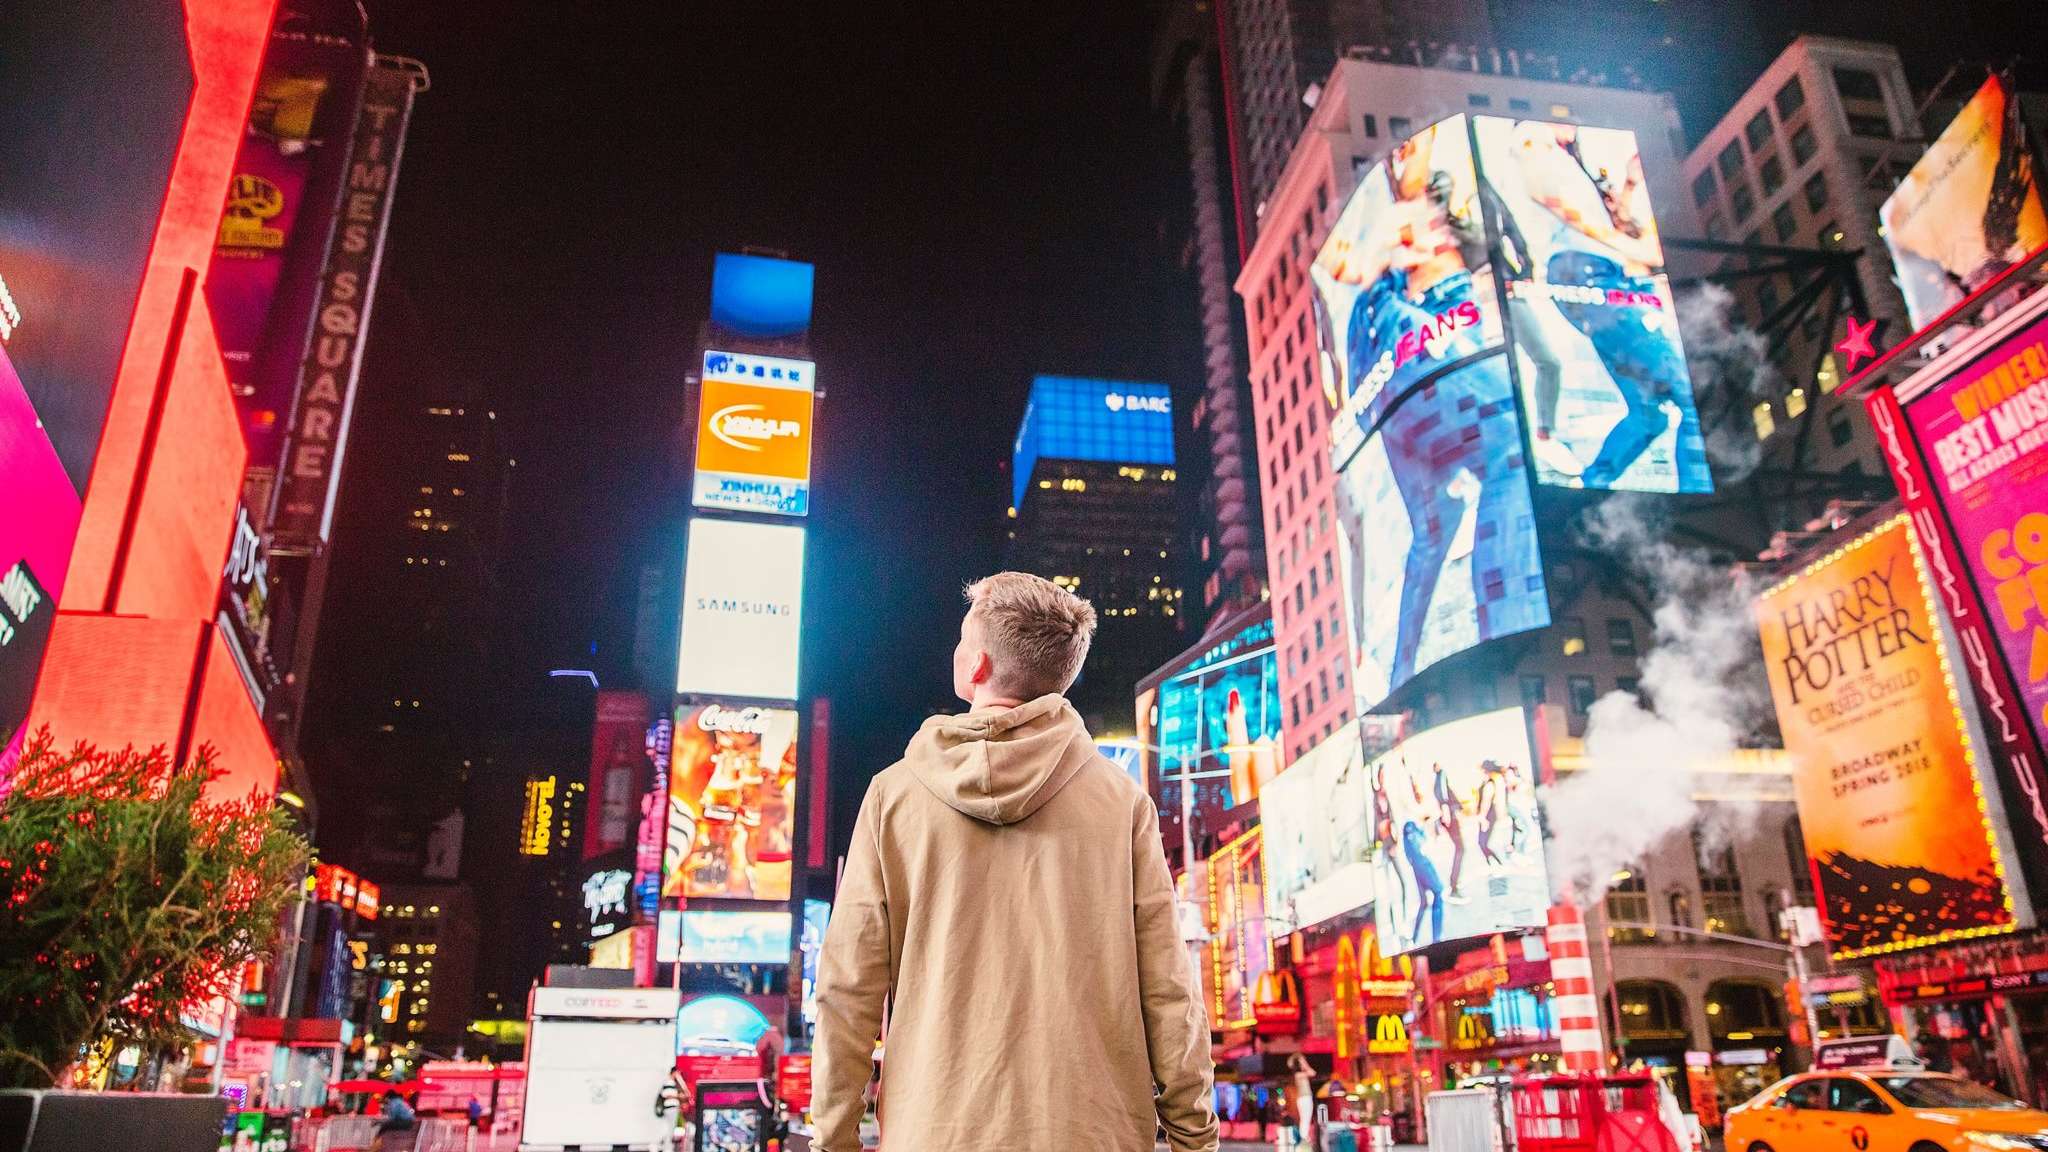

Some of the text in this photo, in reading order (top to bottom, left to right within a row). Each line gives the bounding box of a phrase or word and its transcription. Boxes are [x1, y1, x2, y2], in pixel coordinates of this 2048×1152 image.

[294, 104, 397, 478] TIMES SQUARE
[1395, 301, 1481, 368] JEANS
[1933, 414, 1994, 477] BEST
[720, 480, 782, 498] XINHUA
[697, 598, 790, 616] SAMSUNG
[1781, 556, 1897, 656] HARRY
[1783, 608, 1927, 705] POTTER
[1868, 667, 1921, 701] CHILD
[1832, 739, 1921, 780] BROADWAY
[1833, 770, 1890, 799] SPRING
[531, 775, 557, 855] NOVOTEL
[1992, 972, 2031, 989] SONY
